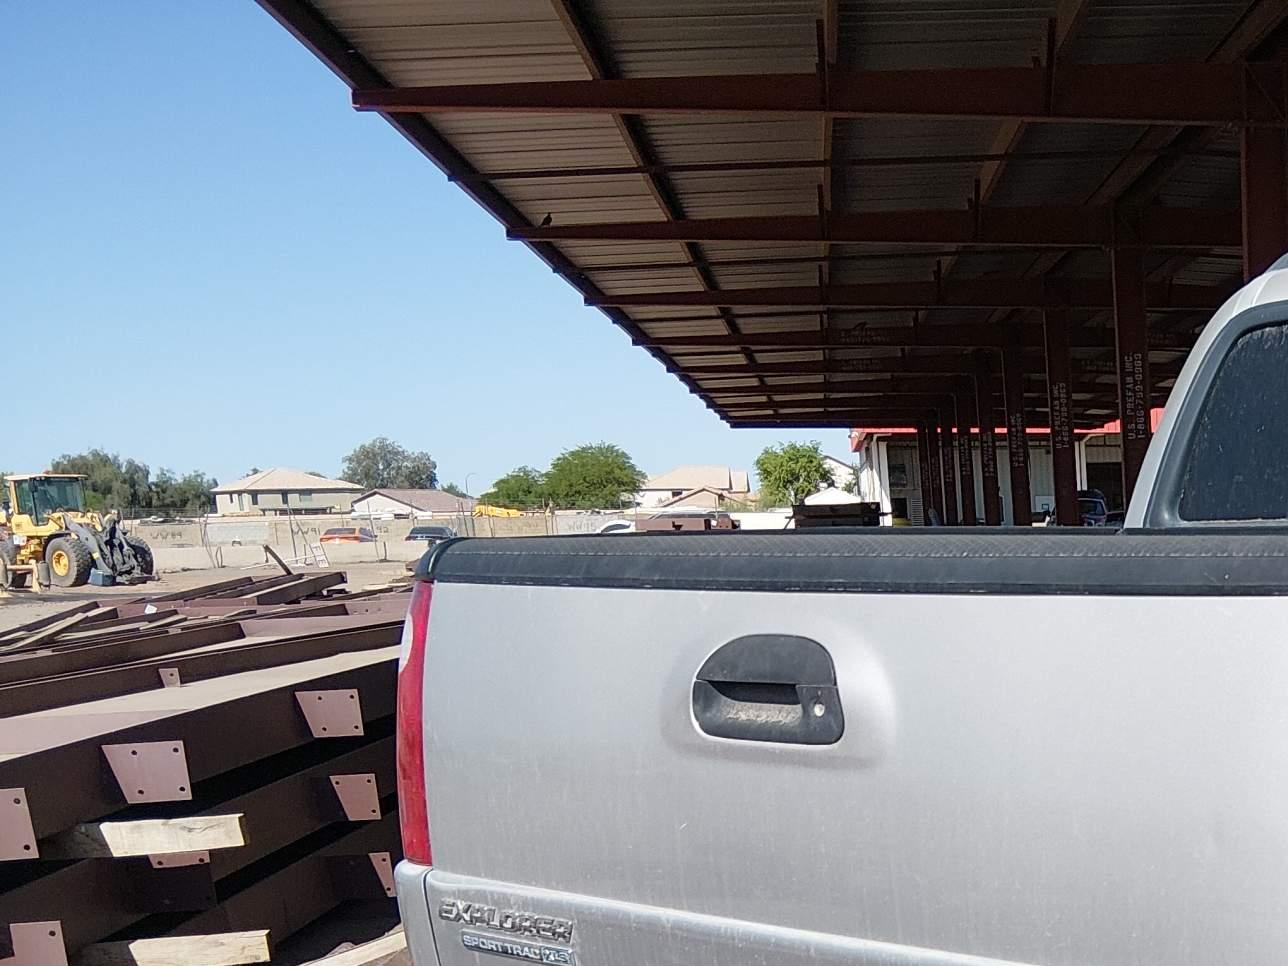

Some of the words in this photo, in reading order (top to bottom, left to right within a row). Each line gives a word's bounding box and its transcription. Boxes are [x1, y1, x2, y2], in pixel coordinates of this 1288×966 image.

[439, 898, 574, 944] EXPLORER
[463, 935, 504, 953] SPORT
[503, 943, 541, 960] TRAC
